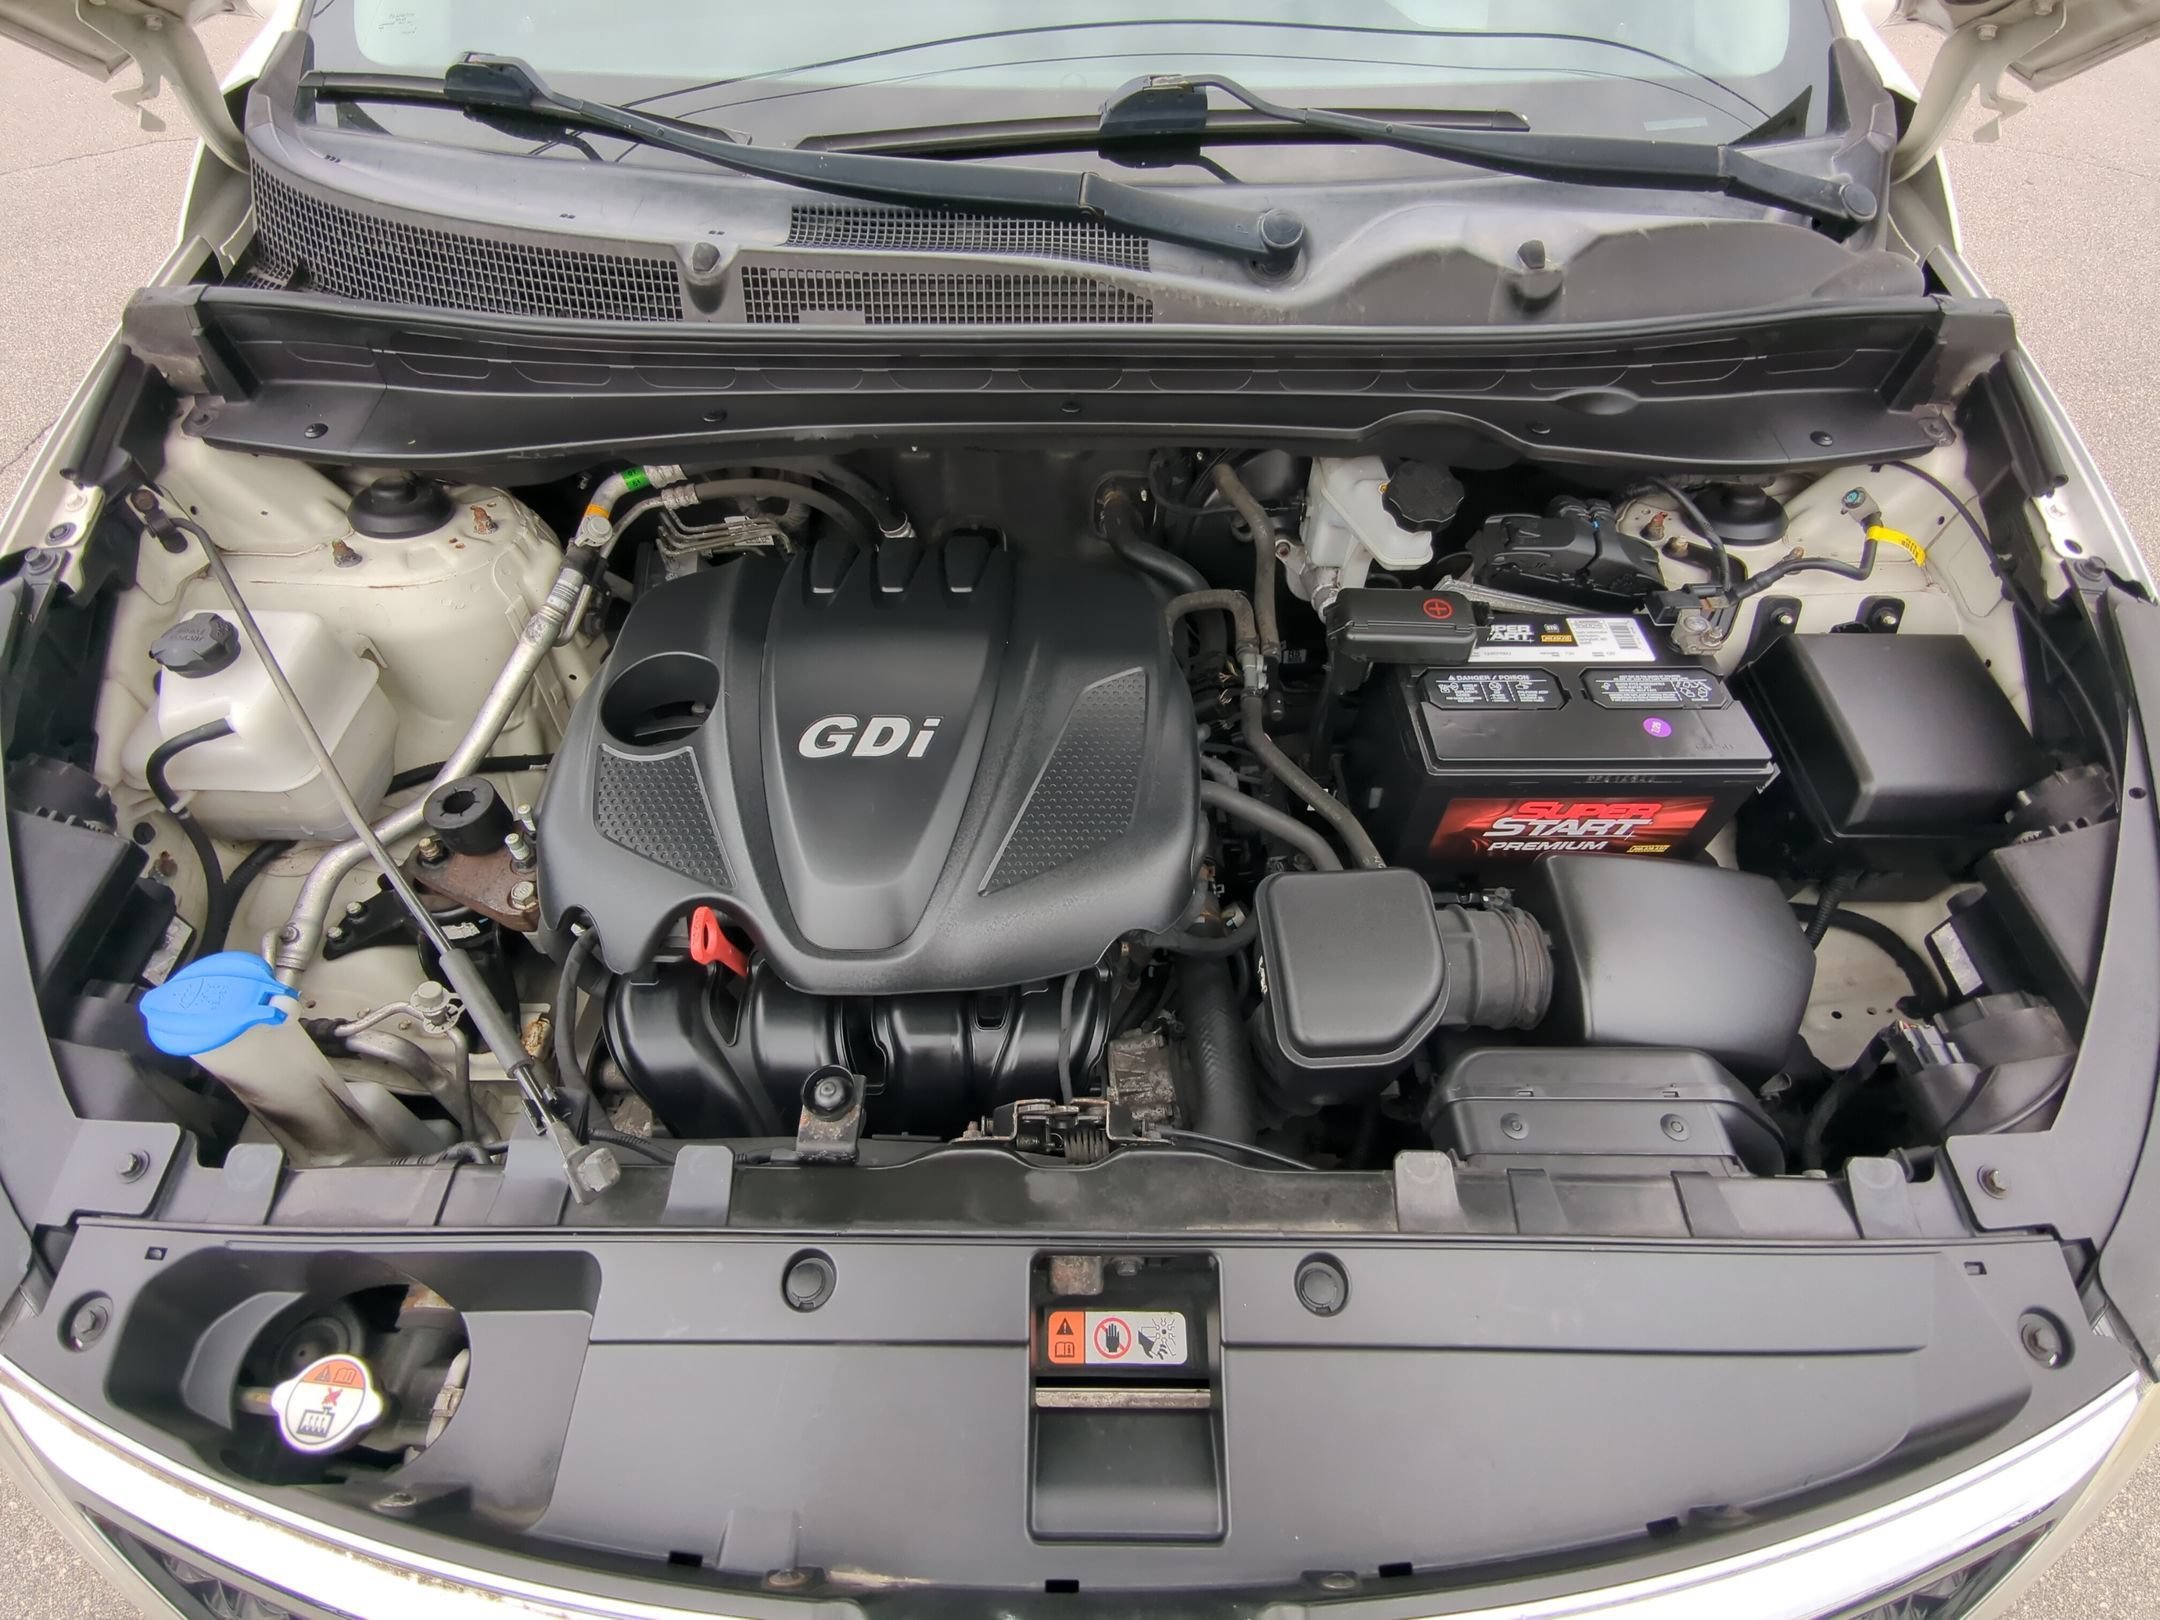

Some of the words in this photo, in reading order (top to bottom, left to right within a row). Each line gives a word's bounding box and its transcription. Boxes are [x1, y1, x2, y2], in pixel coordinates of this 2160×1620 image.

[798, 715, 942, 759] GDi
[1511, 801, 1662, 819] SUPER
[1482, 816, 1654, 839] START
[1486, 840, 1609, 852] PREMIUM
